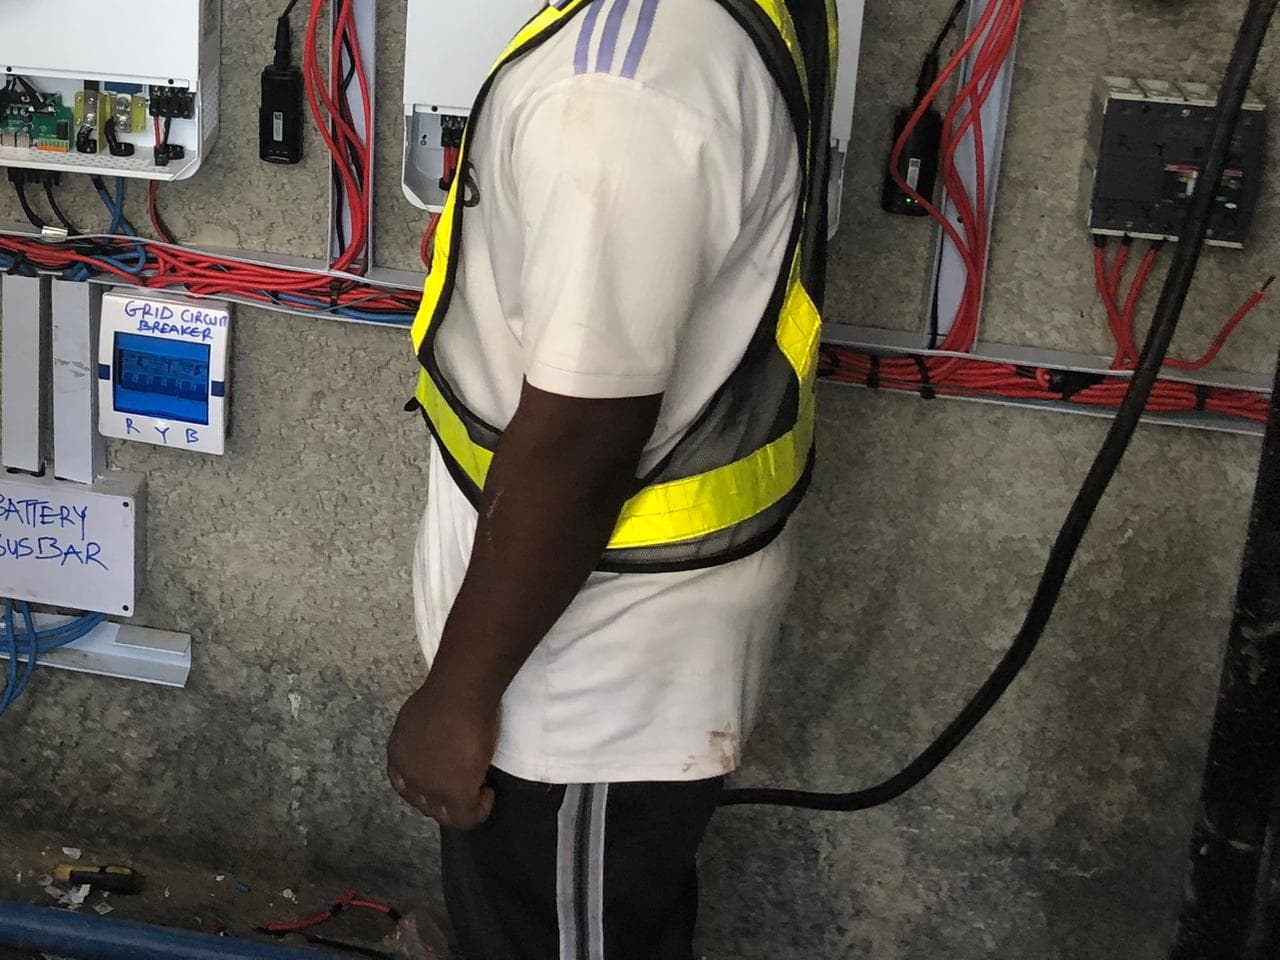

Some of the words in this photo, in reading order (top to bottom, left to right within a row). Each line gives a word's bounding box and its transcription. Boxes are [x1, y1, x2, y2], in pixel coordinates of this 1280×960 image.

[124, 300, 174, 320] GRID
[137, 319, 213, 341] BREAKER
[125, 417, 140, 434] R
[154, 426, 170, 444] Y
[185, 427, 199, 443] B
